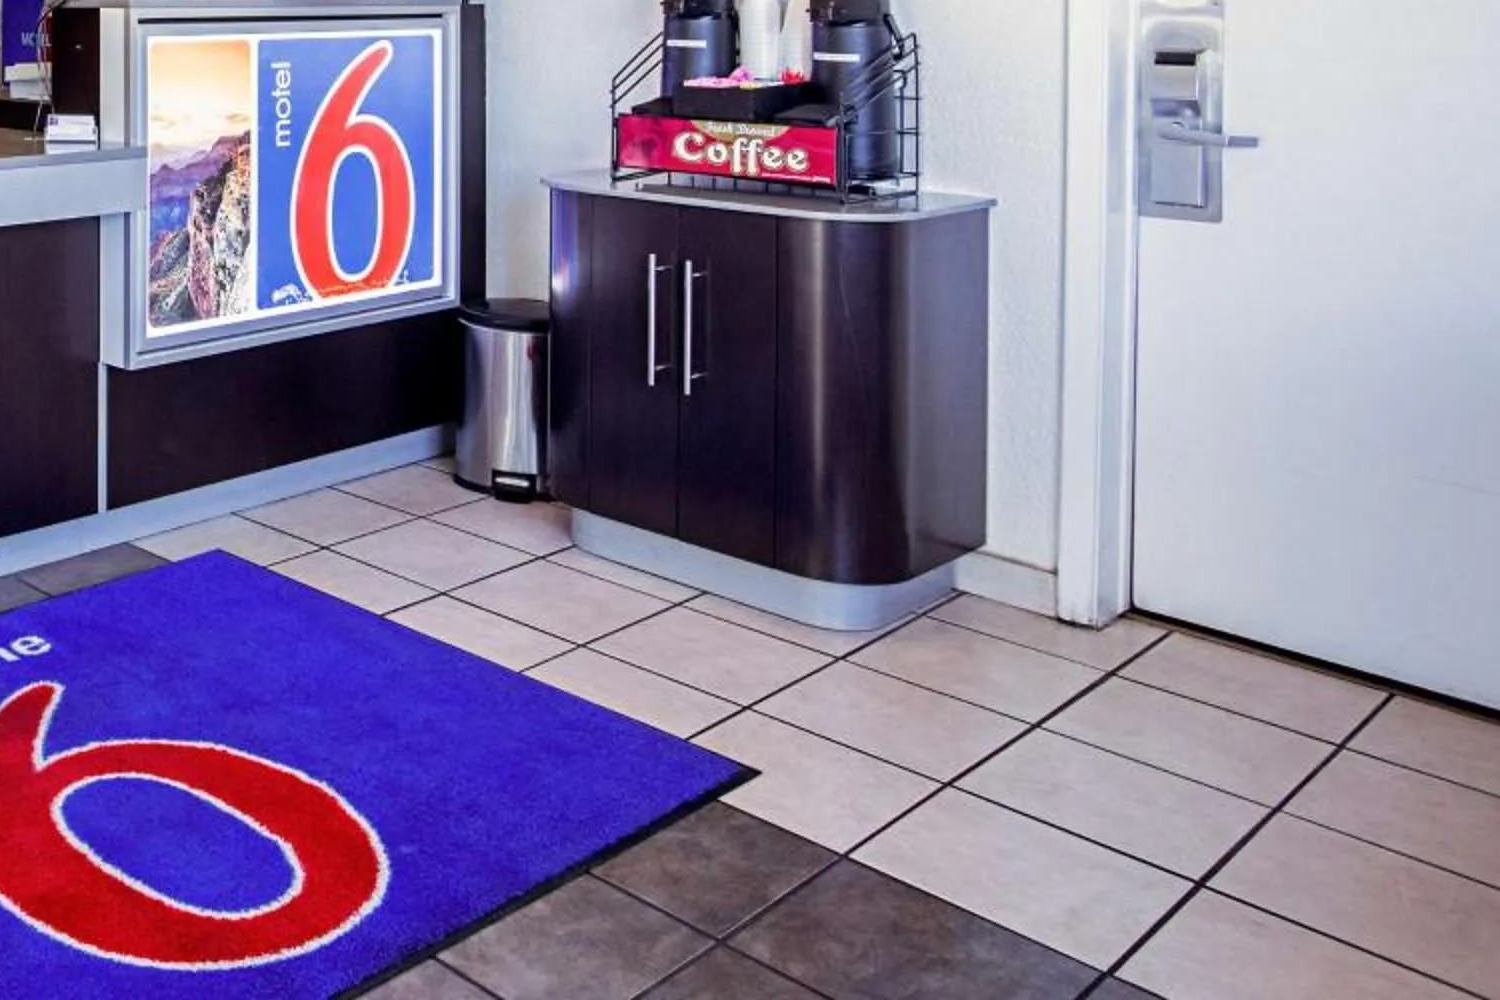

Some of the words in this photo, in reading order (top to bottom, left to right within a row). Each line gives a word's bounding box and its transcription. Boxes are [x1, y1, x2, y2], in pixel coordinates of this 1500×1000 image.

[271, 60, 292, 148] motel
[289, 39, 415, 300] 6
[672, 131, 810, 178] Coffee
